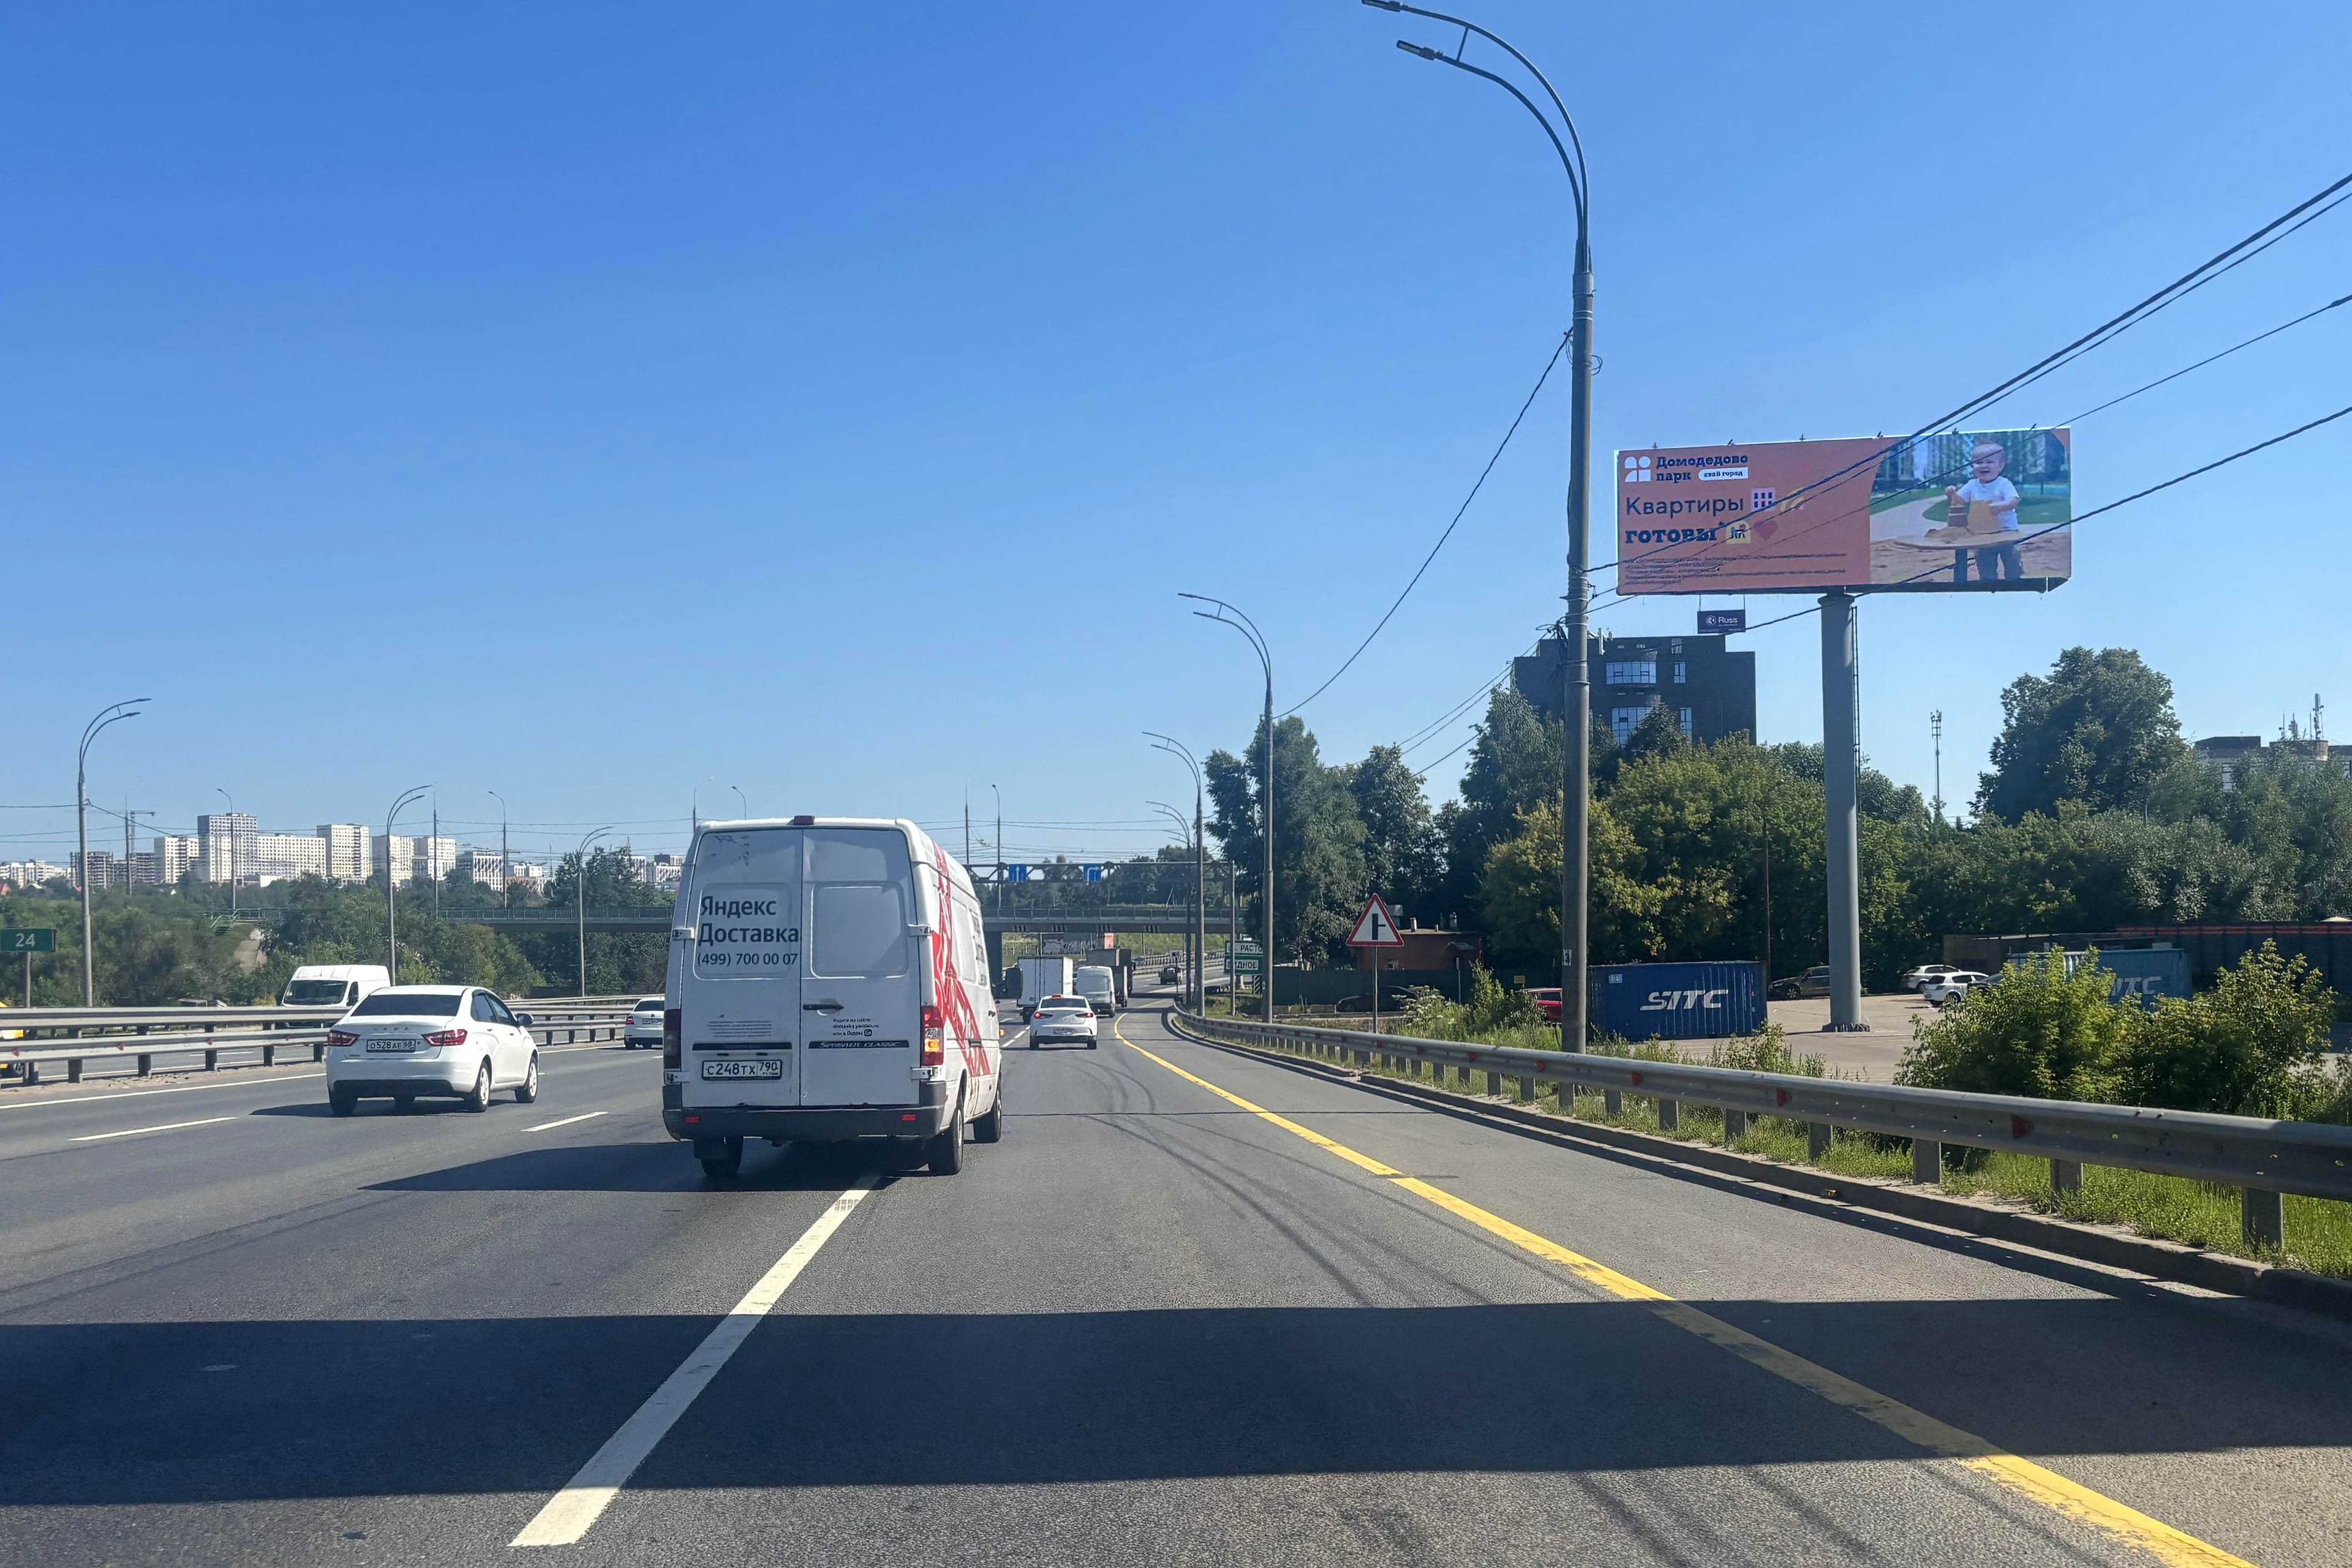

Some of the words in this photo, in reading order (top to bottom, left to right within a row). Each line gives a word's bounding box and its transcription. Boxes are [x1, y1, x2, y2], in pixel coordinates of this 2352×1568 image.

[1656, 455, 1748, 469] Домодедово
[1656, 472, 1692, 483] парк
[1626, 497, 1744, 519] Квартиры
[701, 896, 777, 918] Яндекс
[15, 933, 36, 947] 24
[698, 922, 799, 946] Доставка
[698, 952, 731, 967] (499)
[736, 953, 760, 965] 700
[763, 953, 779, 965] 00
[783, 953, 798, 965] 07
[2111, 976, 2162, 996] ITC
[1640, 989, 1728, 1011] SITC
[760, 1062, 778, 1071] 790
